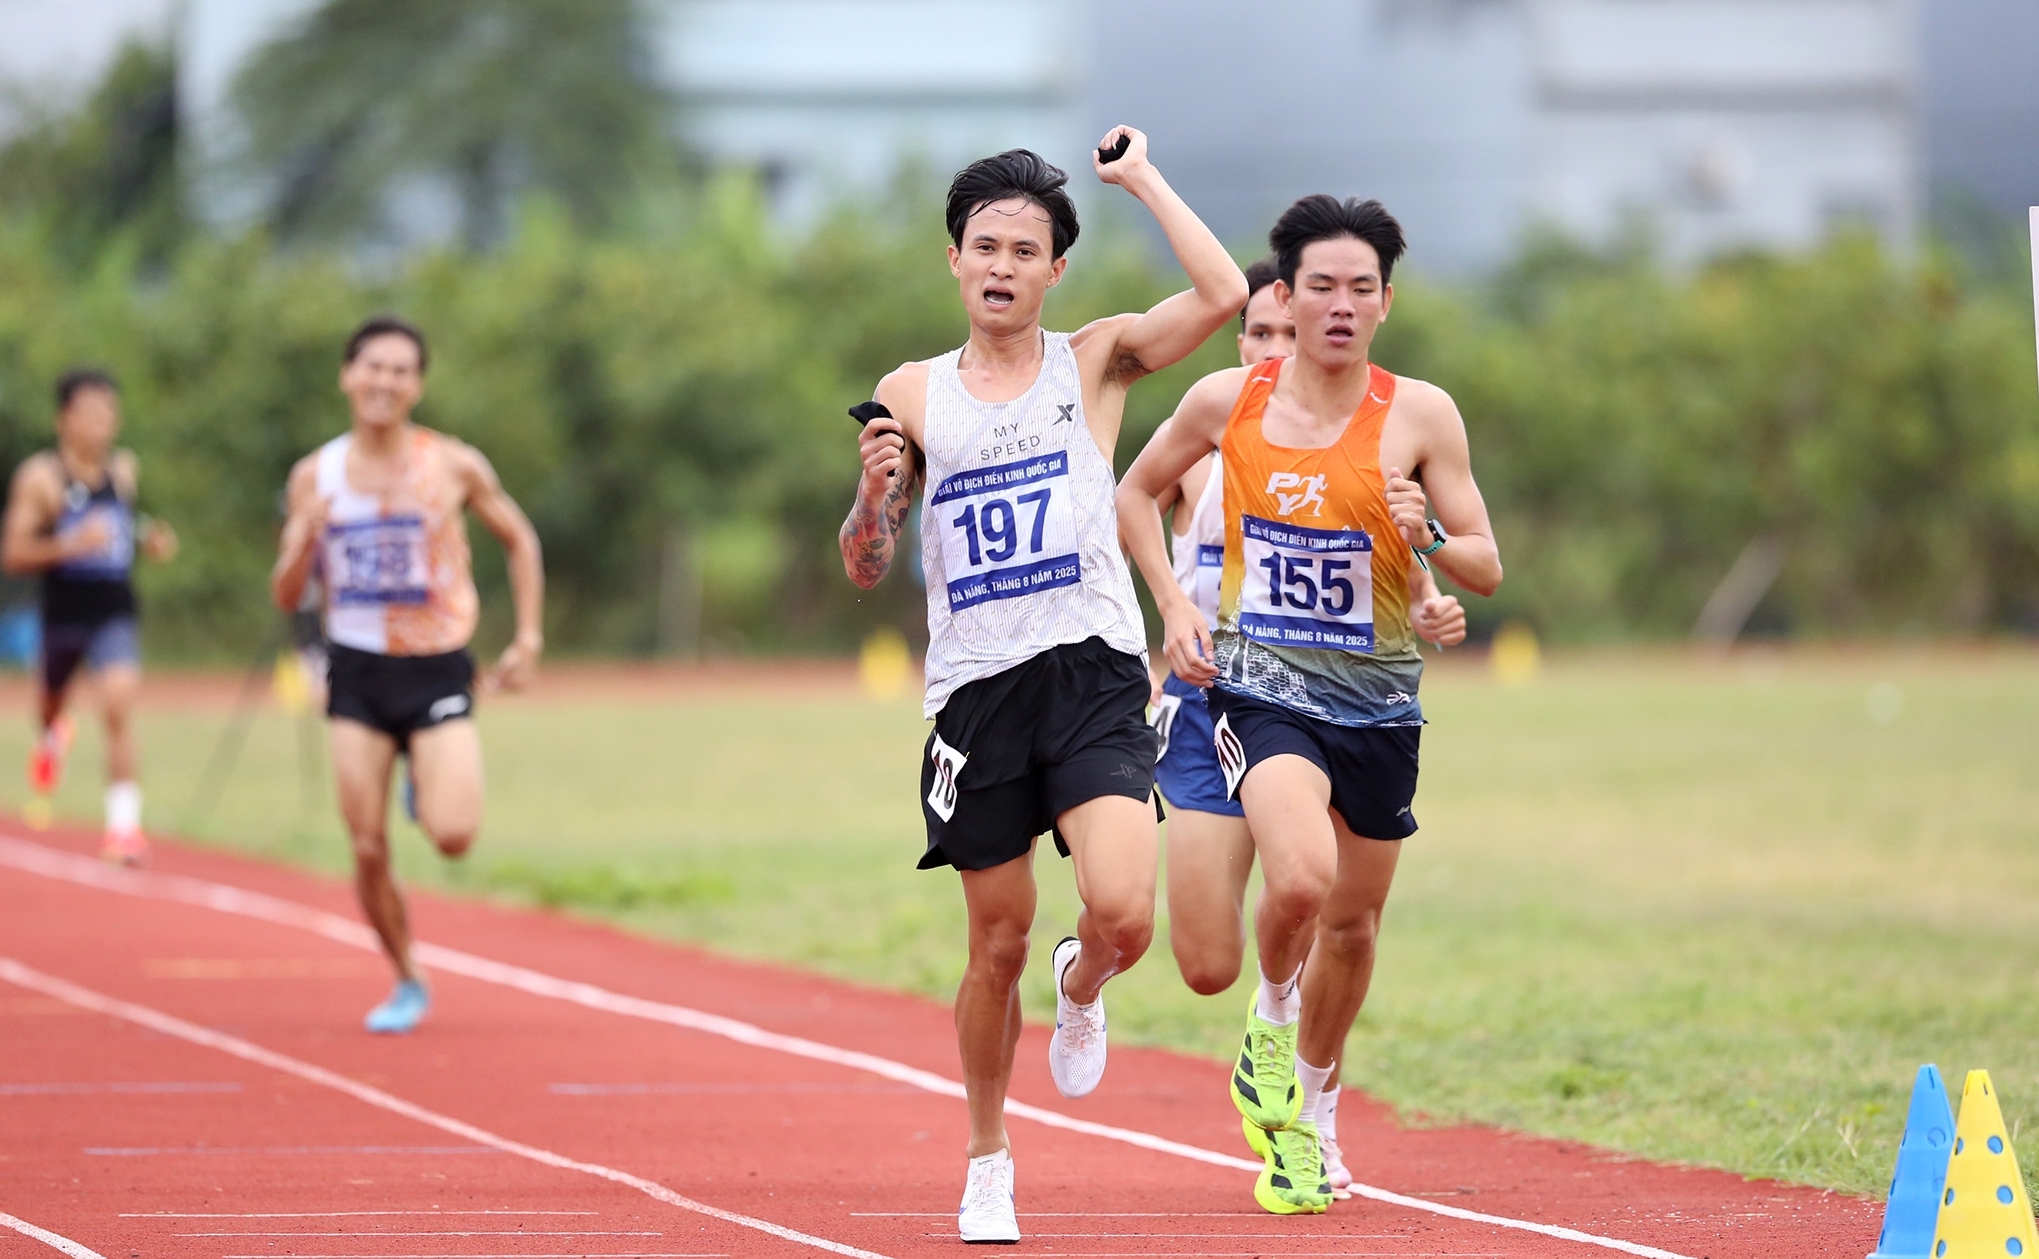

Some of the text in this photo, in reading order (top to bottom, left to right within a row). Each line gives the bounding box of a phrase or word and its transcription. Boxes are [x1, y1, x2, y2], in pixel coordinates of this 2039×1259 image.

[994, 423, 1018, 438] MY
[980, 435, 1041, 460] SPEED
[964, 476, 983, 491] ĐỊCH
[1005, 468, 1025, 481] KINH
[1026, 460, 1048, 478] QUỐC
[1049, 458, 1062, 471] GIA
[953, 488, 1052, 567] 197
[1308, 537, 1327, 549] KINH
[1328, 536, 1349, 550] QUỐC
[1351, 540, 1364, 549] GIA
[991, 577, 1021, 592] THÁNG
[1023, 576, 1029, 587] 8
[1031, 570, 1053, 585] NĂM
[1055, 565, 1077, 579] 2025
[1259, 551, 1355, 616] 155
[1284, 627, 1313, 641] THÁNG
[1315, 632, 1322, 642] 8
[1323, 632, 1343, 645] NĂM
[1346, 635, 1368, 646] 2025
